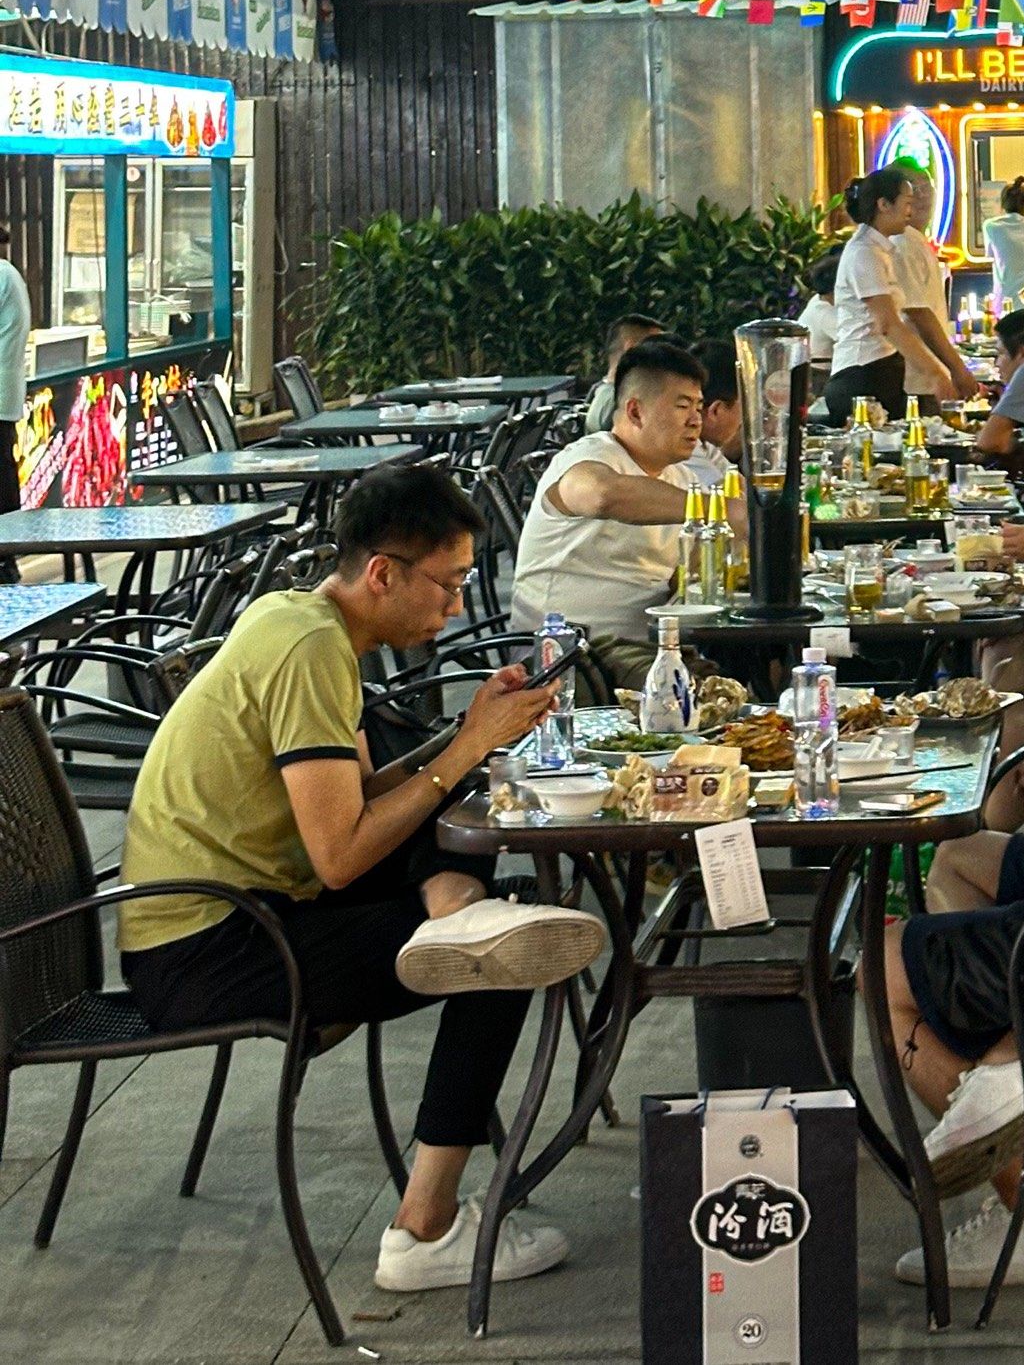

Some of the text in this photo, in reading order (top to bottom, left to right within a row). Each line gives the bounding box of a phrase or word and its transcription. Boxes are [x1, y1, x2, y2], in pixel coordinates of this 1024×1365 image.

[915, 47, 977, 82] I'LL
[708, 1201, 794, 1243] 汾酒
[742, 1323, 762, 1338] 20
